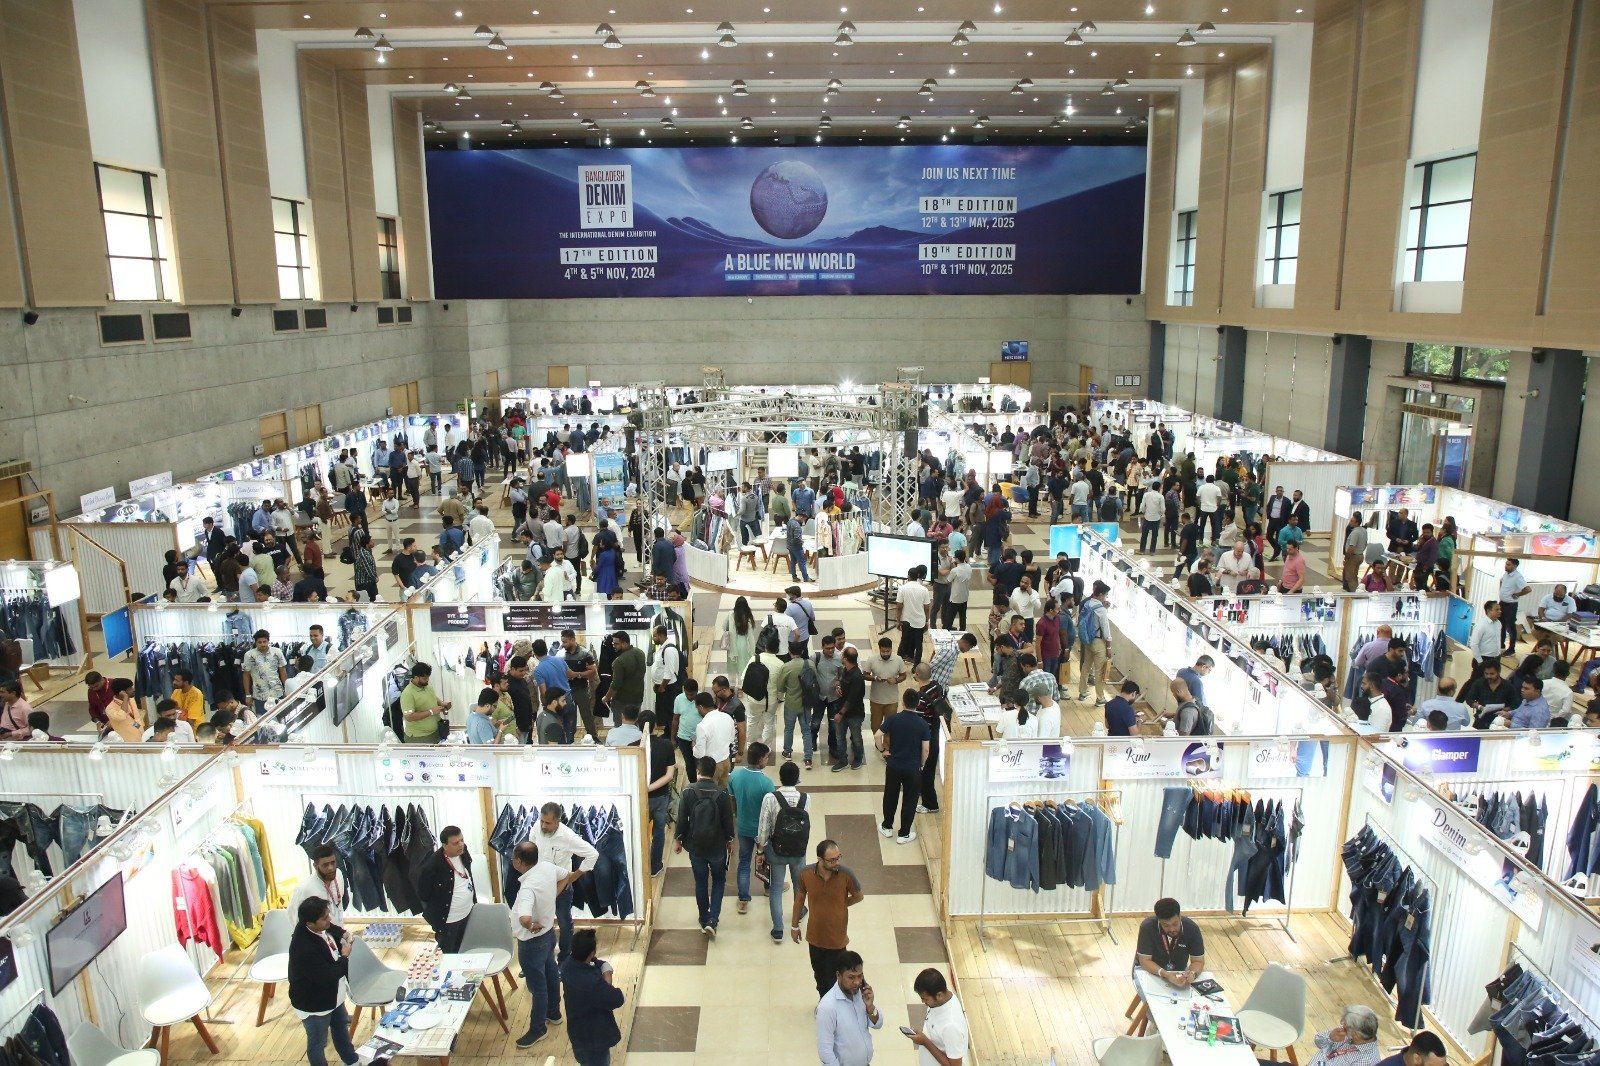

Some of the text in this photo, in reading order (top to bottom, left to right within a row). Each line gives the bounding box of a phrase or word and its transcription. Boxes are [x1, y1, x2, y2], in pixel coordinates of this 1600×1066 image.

[585, 170, 625, 182] BANGLADESH
[921, 167, 1016, 180] JOIN US NEXT TIME
[586, 183, 626, 206] DENIM
[924, 198, 1014, 211] 18TH EDITION
[586, 210, 627, 223] EXPO
[921, 216, 1015, 229] 12TH & 13TH MAY, 2025
[569, 231, 607, 239] INTERNATIONAL
[626, 230, 657, 238] EXHIBITION
[565, 248, 654, 262] 17TH EDITION
[923, 245, 1012, 258] 19TH EDITION
[724, 252, 856, 271] A BLUE NEW WORLD
[564, 266, 656, 280] 4TH & 5TH NOV, 2024
[920, 263, 1013, 276] 10TH & 11TH NOV, 2025
[1432, 748, 1469, 762] Glamper
[1431, 807, 1467, 848] Denim
